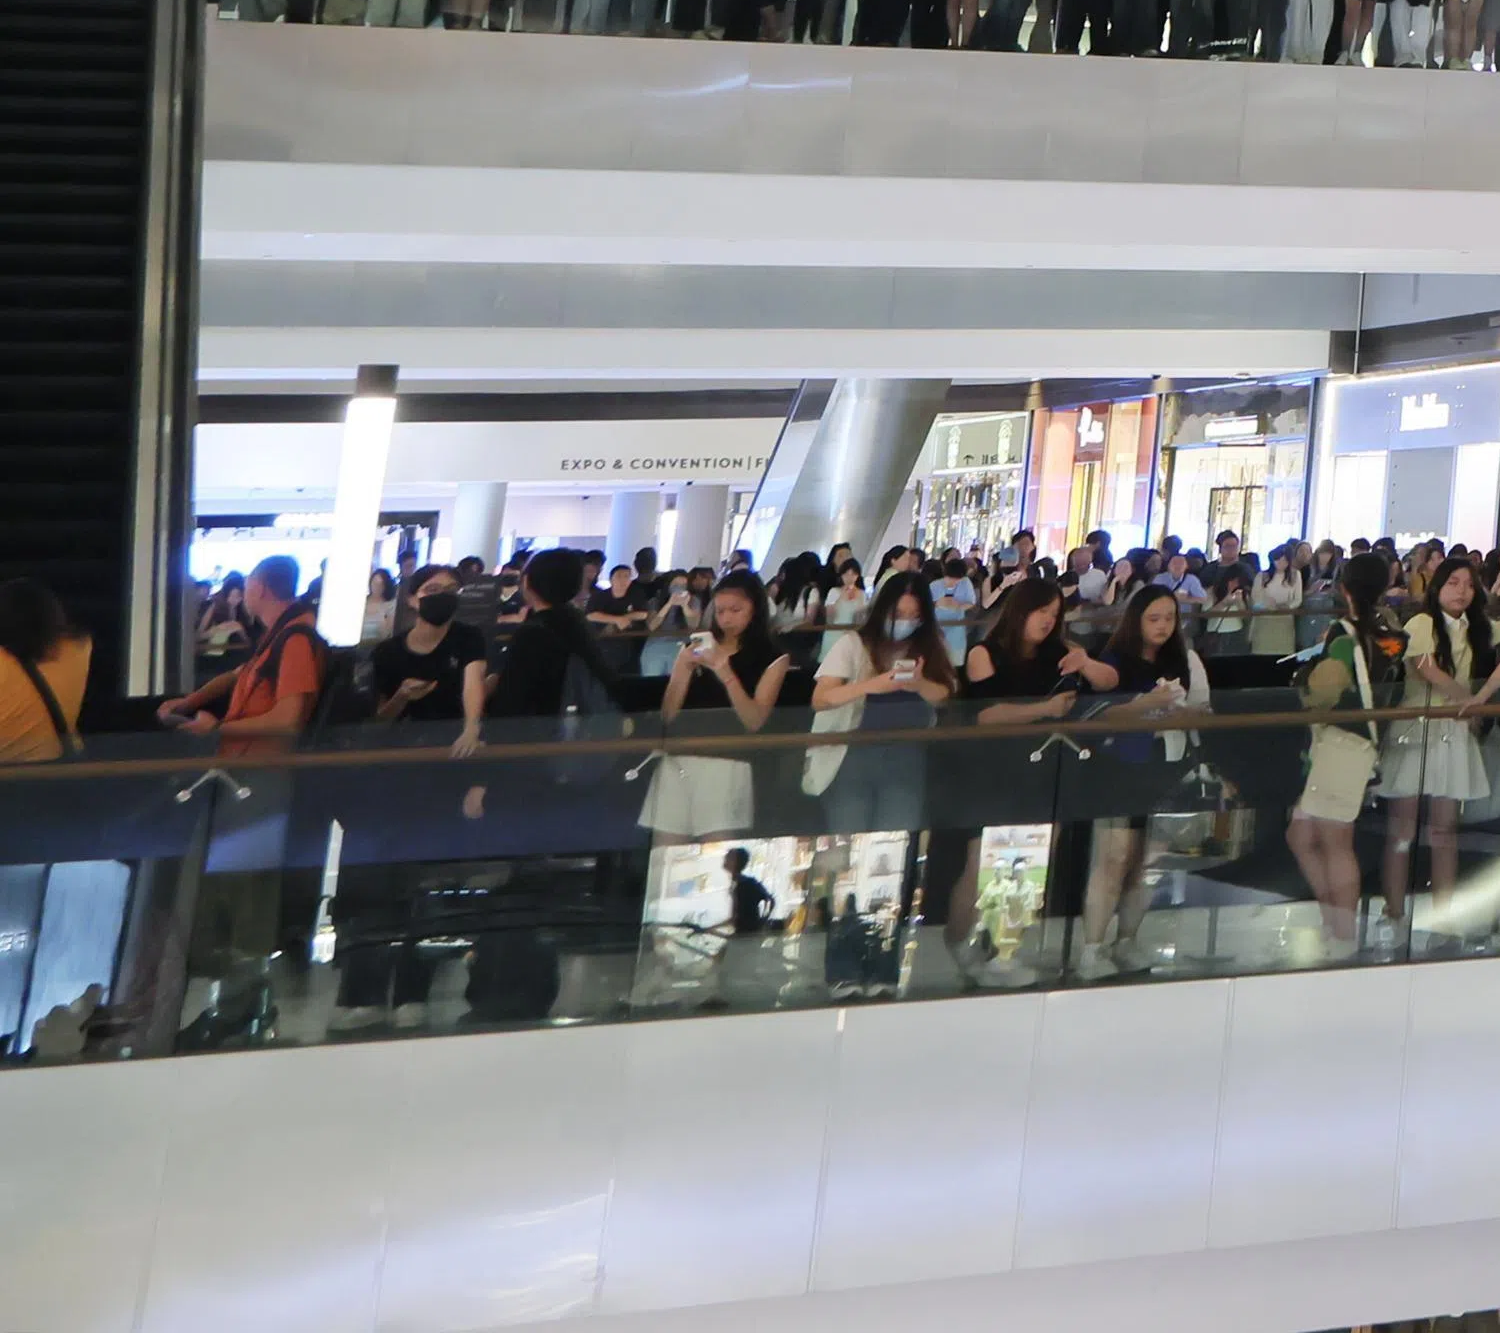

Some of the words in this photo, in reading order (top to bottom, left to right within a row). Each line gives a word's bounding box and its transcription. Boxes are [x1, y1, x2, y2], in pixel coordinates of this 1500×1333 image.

[560, 459, 606, 471] EXPO
[612, 458, 624, 470] &
[630, 457, 744, 471] CONVENTION
